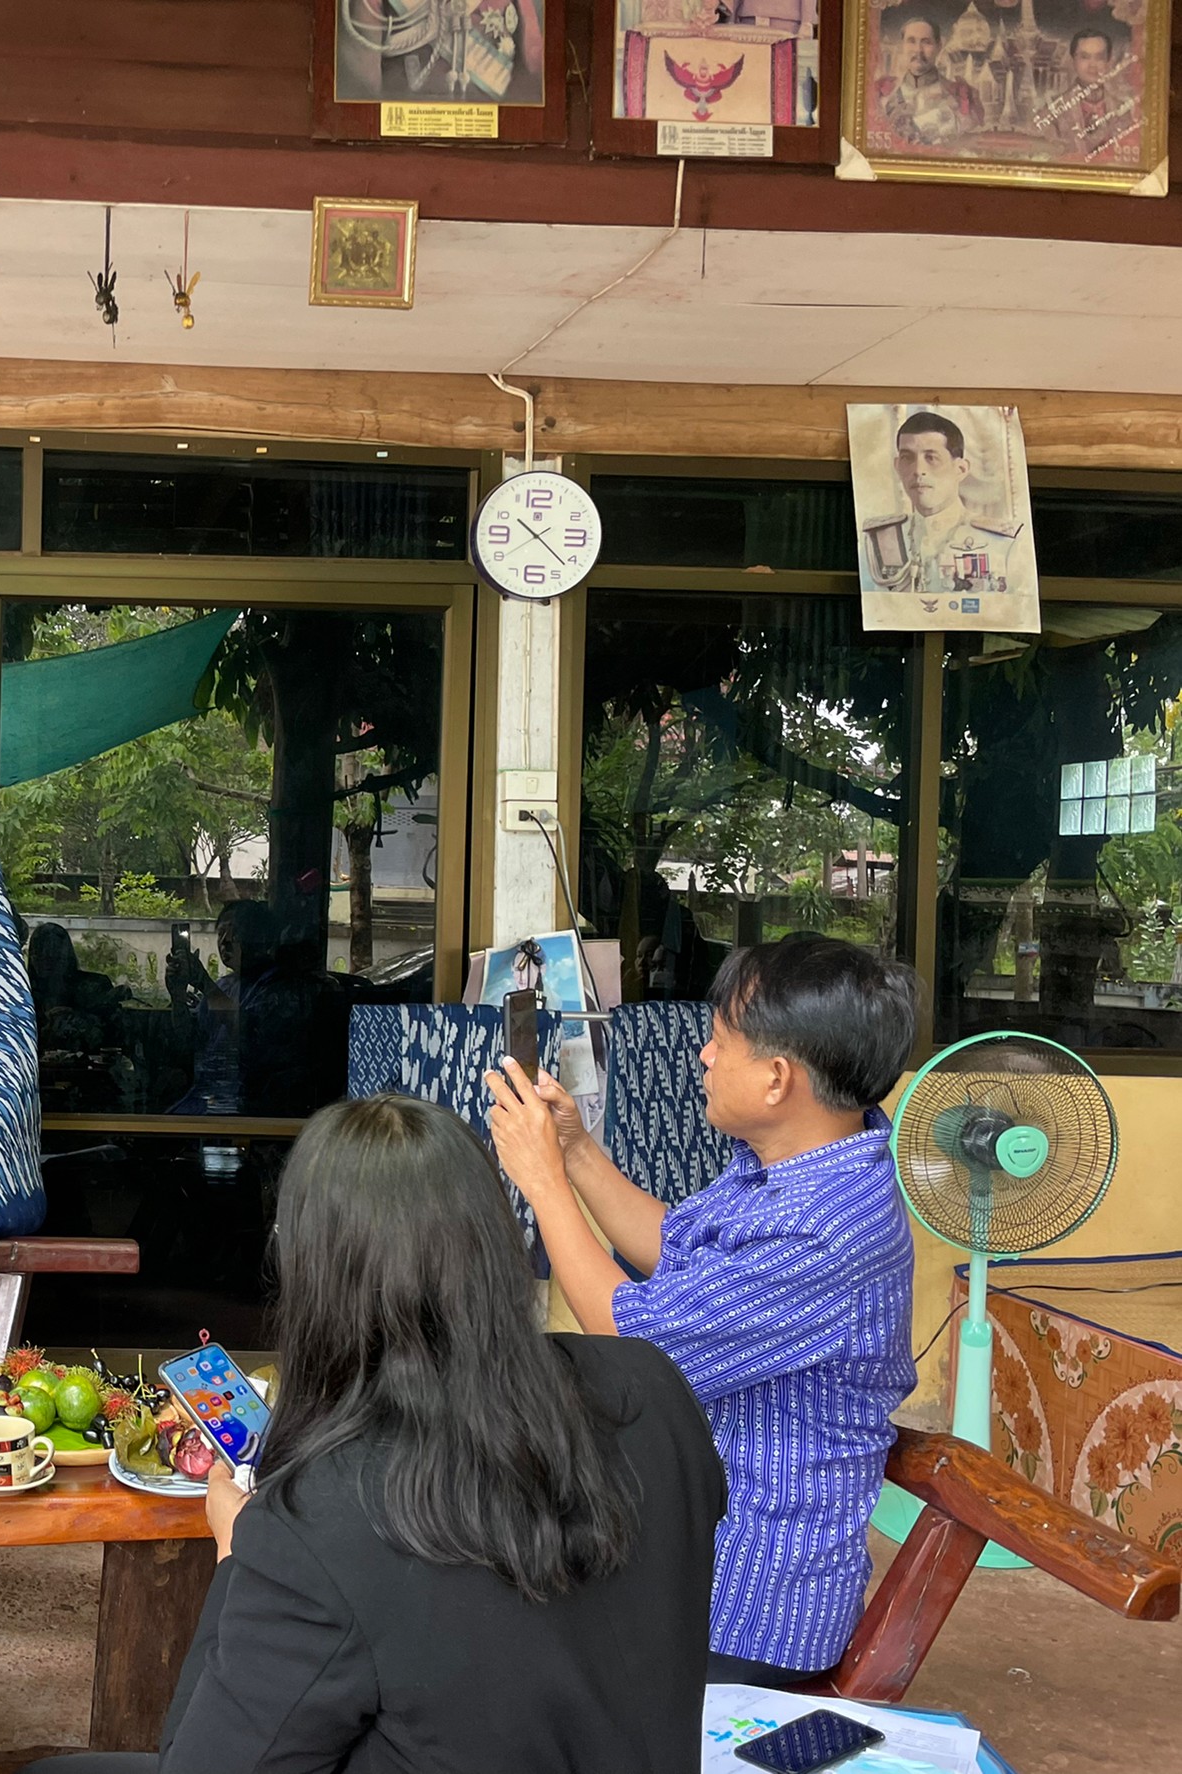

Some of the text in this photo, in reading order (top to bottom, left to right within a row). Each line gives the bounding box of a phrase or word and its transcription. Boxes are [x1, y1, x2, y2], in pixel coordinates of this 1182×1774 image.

[526, 489, 553, 508] 12
[497, 511, 510, 520] 10
[570, 512, 581, 521] 2
[488, 525, 510, 544] 9
[564, 528, 587, 548] 3
[494, 551, 505, 561] 8
[567, 555, 577, 565] 4
[508, 567, 519, 577] 7
[523, 565, 546, 584] 6
[550, 570, 561, 580] 5
